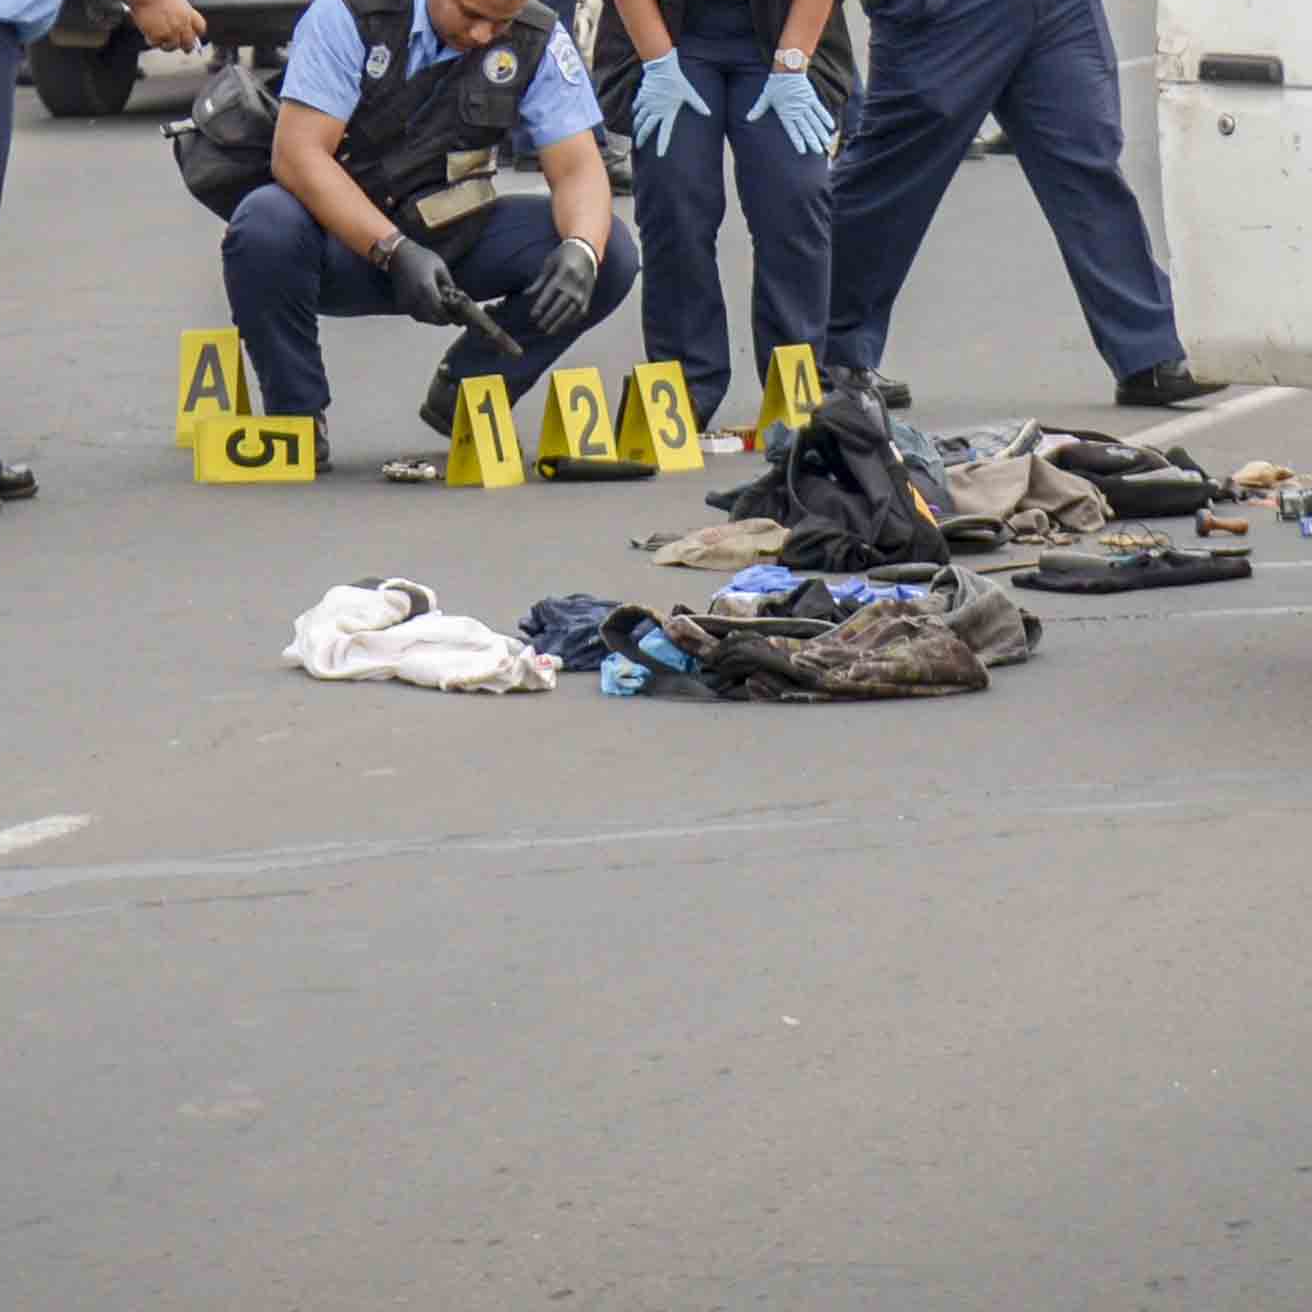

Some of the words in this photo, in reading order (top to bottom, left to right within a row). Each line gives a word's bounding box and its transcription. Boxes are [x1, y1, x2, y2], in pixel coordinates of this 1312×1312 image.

[183, 343, 231, 413] A
[793, 358, 817, 416] 4
[225, 427, 300, 468] 5
[477, 389, 504, 463] 1
[569, 384, 608, 456] 2
[651, 379, 688, 449] 3
